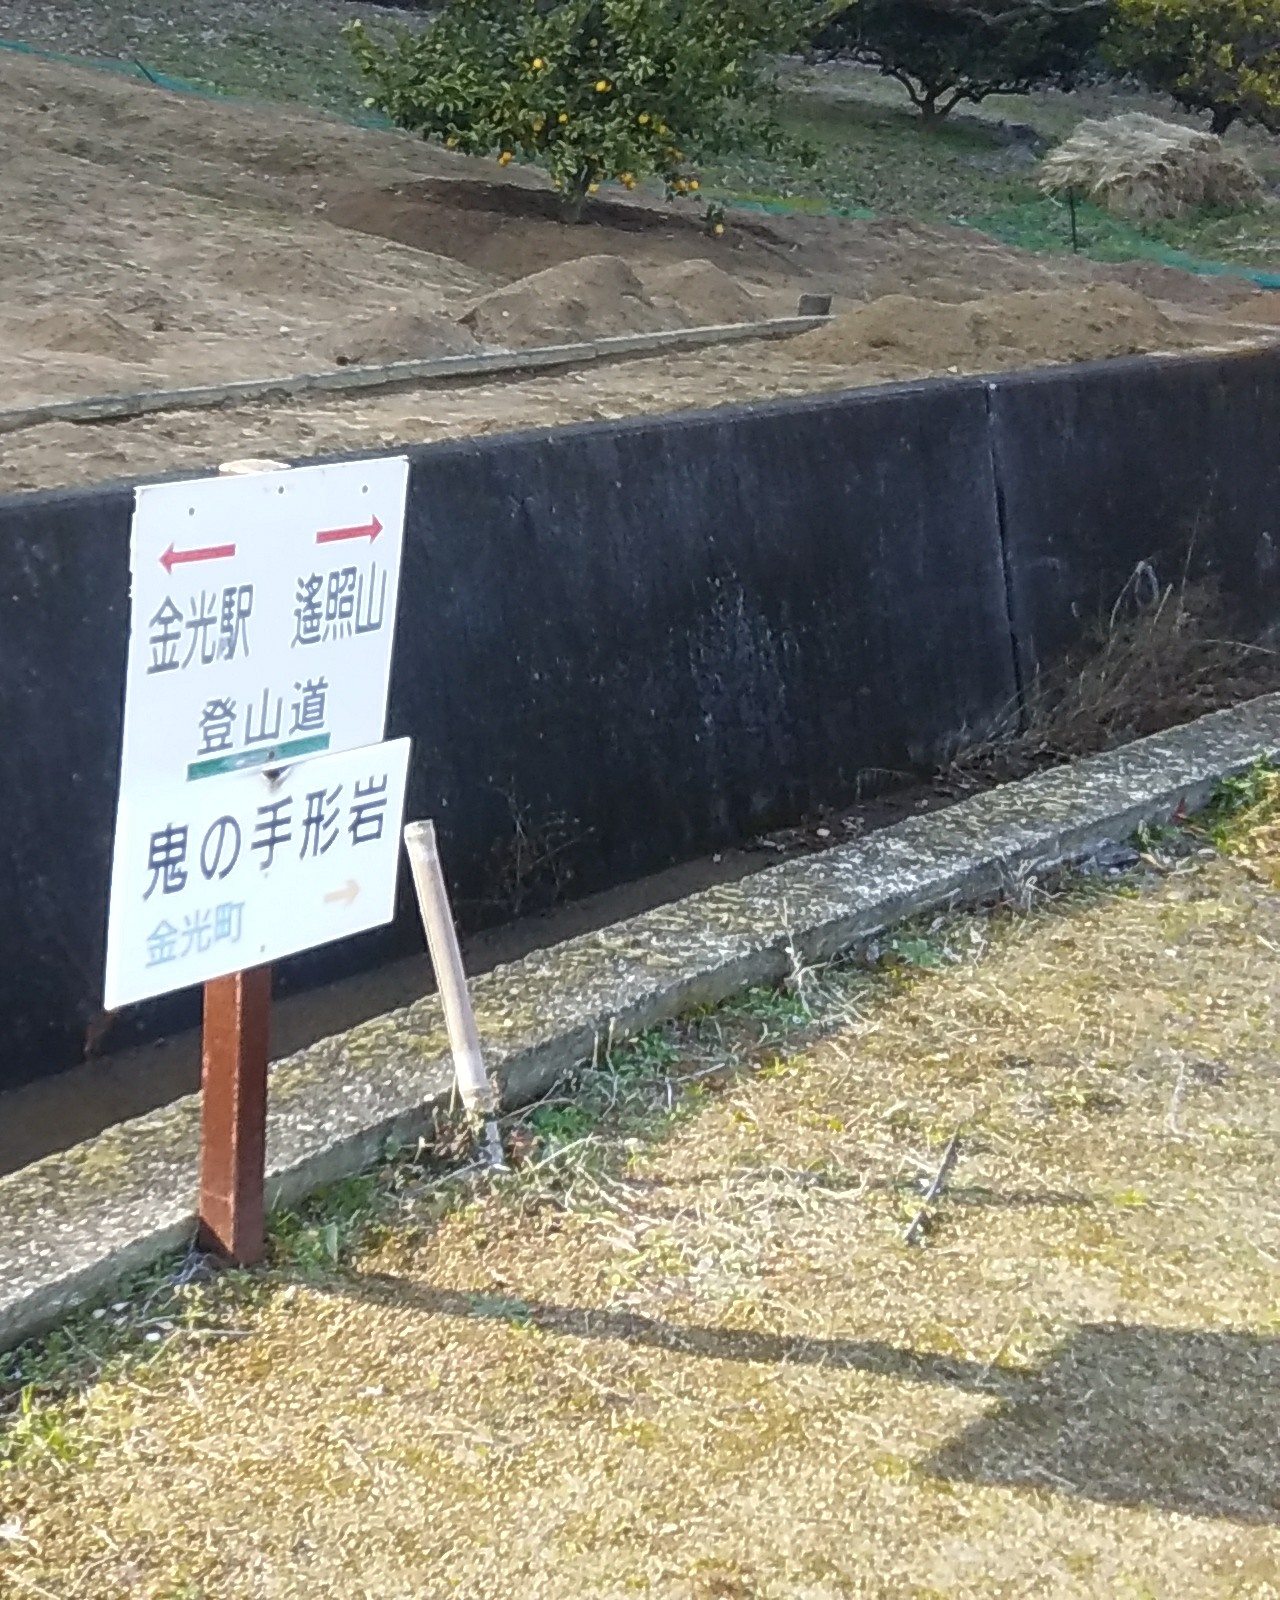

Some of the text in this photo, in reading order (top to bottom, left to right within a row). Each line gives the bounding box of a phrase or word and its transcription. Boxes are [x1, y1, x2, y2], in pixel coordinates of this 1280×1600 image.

[146, 584, 254, 674] 金光駅
[198, 676, 329, 755] 登山道
[143, 774, 388, 900] 鬼の手形岩
[145, 901, 245, 968] 金光町
